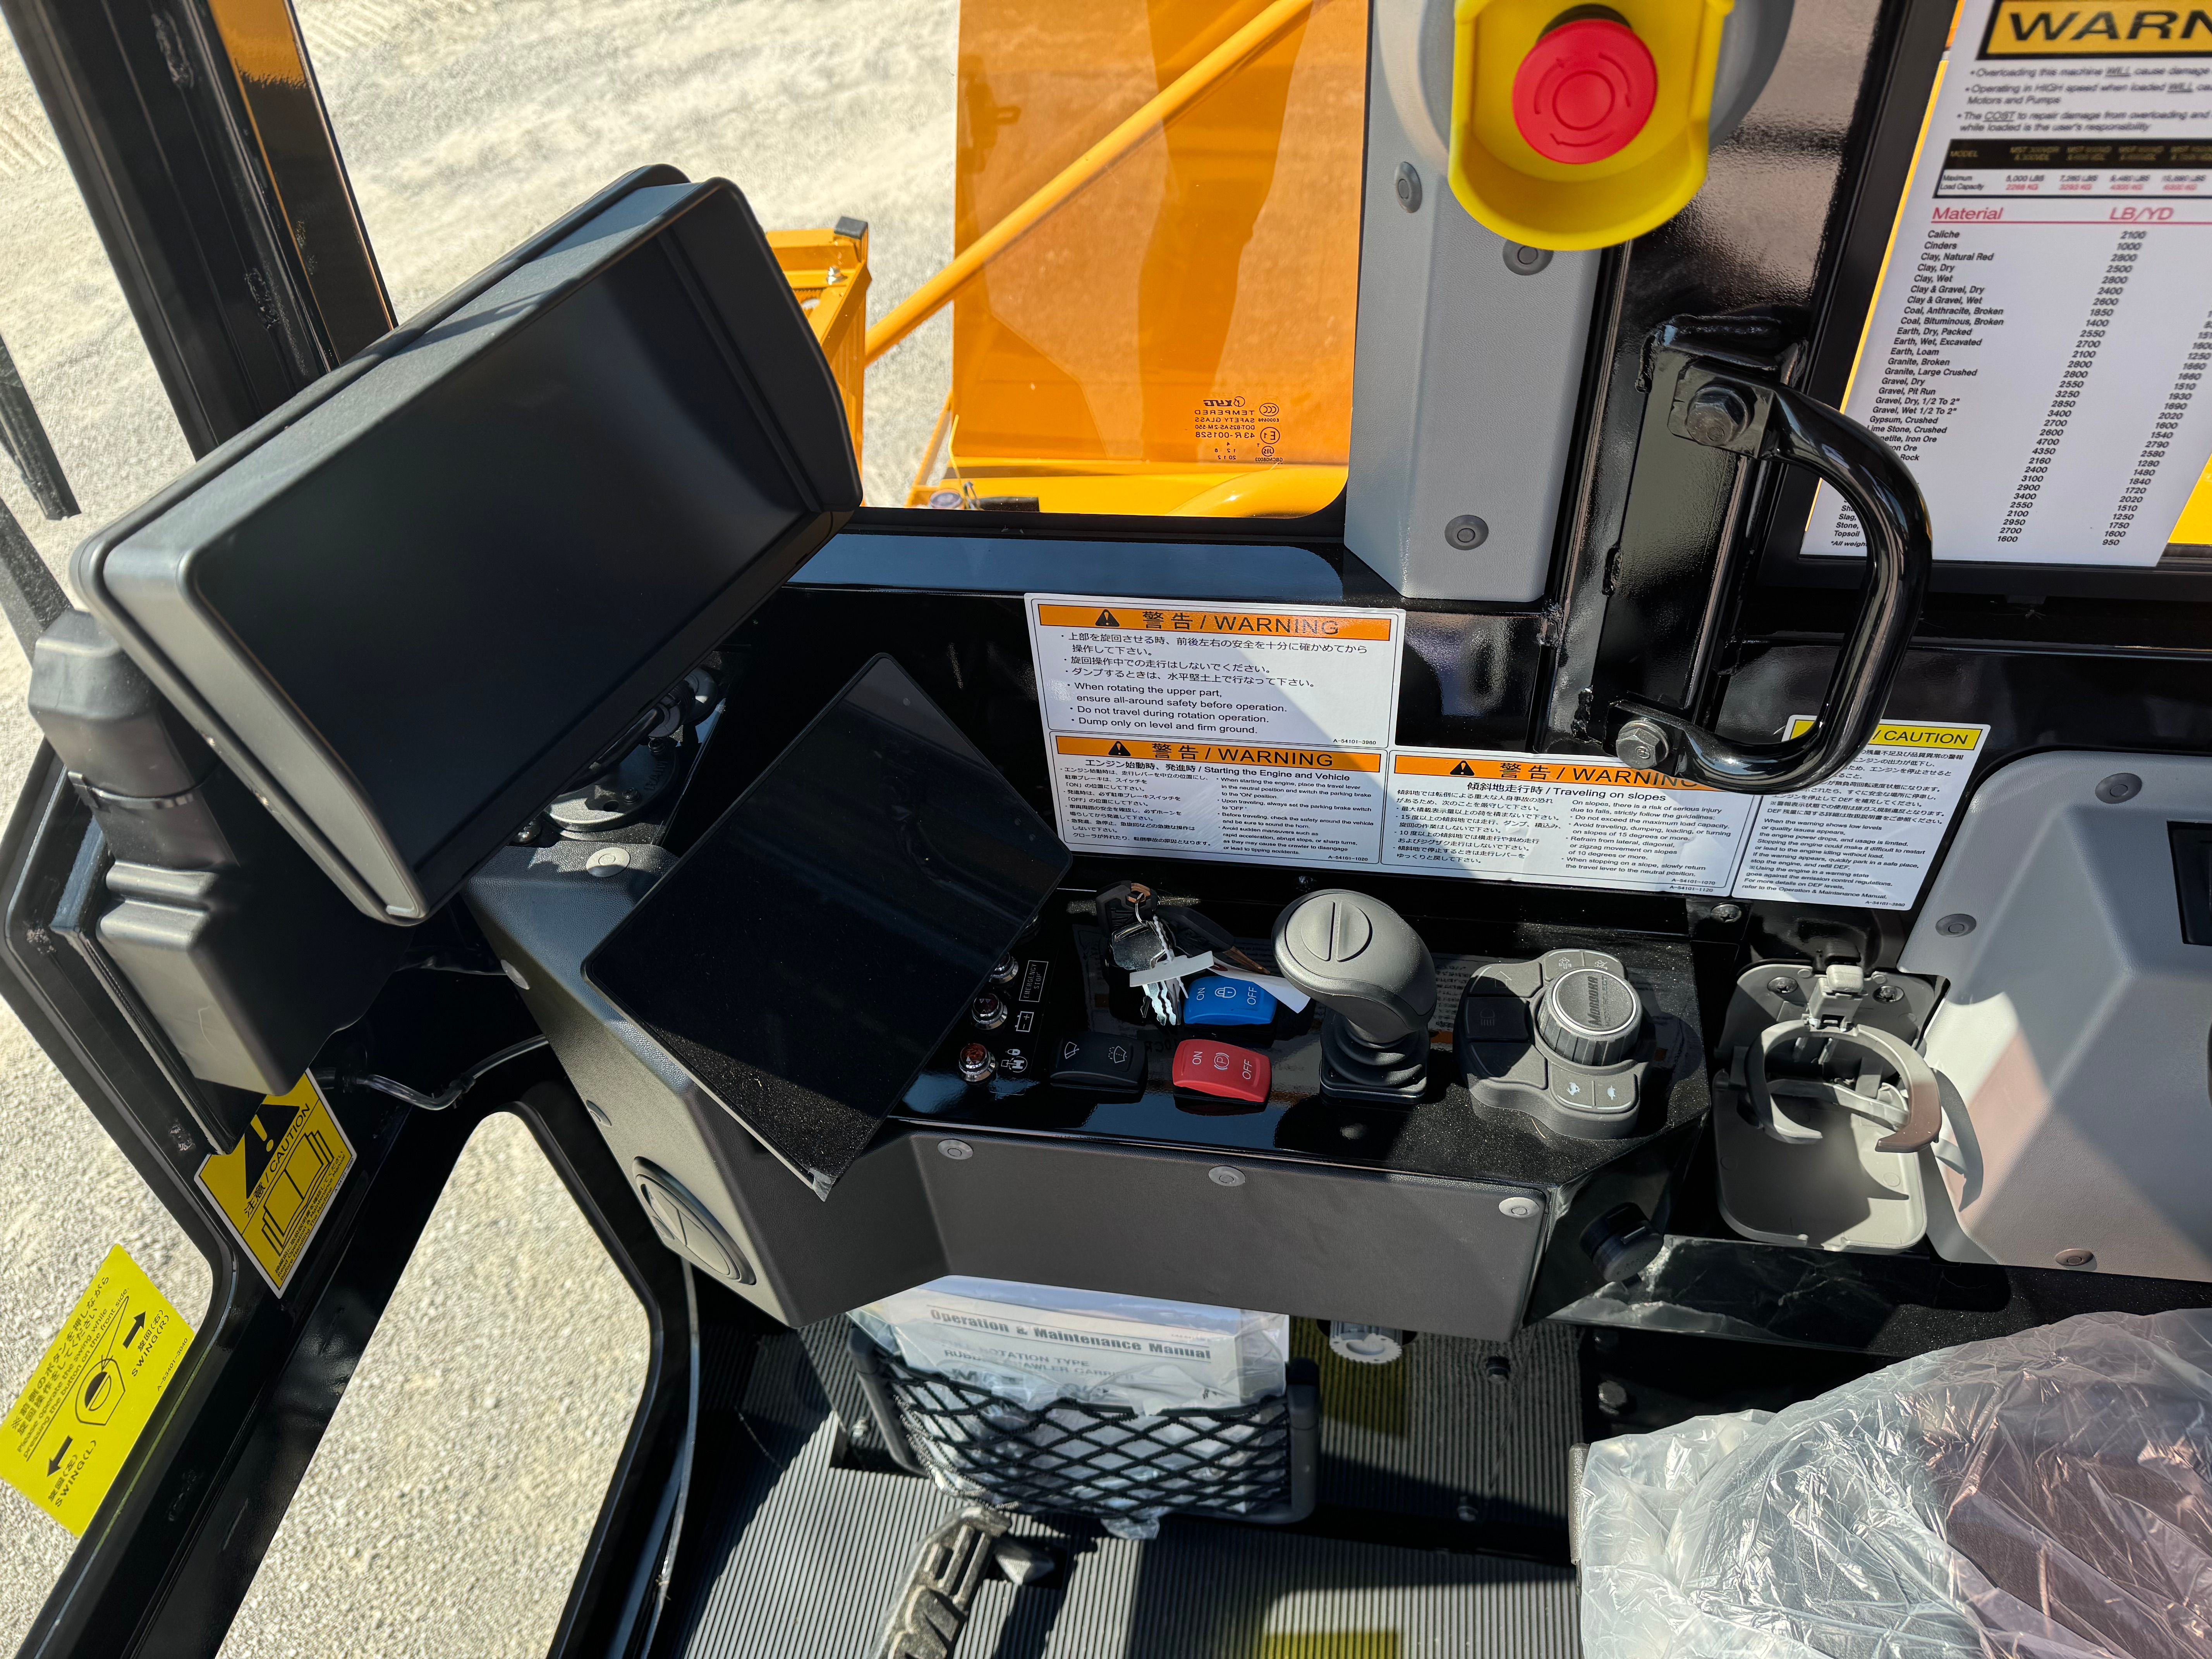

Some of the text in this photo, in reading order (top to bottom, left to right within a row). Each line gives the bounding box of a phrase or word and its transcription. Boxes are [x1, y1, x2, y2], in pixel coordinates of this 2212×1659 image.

[1975, 68, 2037, 79] Overloading
[2039, 68, 2057, 77] this
[2058, 68, 2104, 76] machine
[2105, 67, 2131, 78] WILL
[2167, 67, 2210, 77] damage
[1932, 207, 2003, 220] Material
[2110, 207, 2174, 221] LB/YD
[1927, 230, 1960, 238] Caliche
[1924, 241, 1957, 249] Cinders
[1921, 252, 1940, 262] Clay,
[1976, 252, 1994, 261] Red
[1904, 306, 2004, 316] Coal, Anthracite, Broken
[1893, 337, 1917, 346] Earth,
[1920, 338, 1937, 346] Wet,
[1884, 367, 1915, 376] Granite,
[1917, 368, 1941, 376] Large
[1887, 425, 1911, 433] Stone,
[1142, 611, 1193, 630] 警告
[1214, 615, 1339, 635] WARNING
[1068, 632, 1367, 654] 上部を旋回させる時、前後左右の安全を十分に確かめてから
[1072, 644, 1152, 656] 操作して下さい。
[1071, 656, 1270, 673] 旋回操作中での走行はしないでください。
[1072, 667, 1314, 687] ダンプするときは、水平堅土上で行なって下さい。
[1107, 685, 1144, 694] rotating
[1114, 696, 1163, 705] all-around
[1167, 699, 1197, 708] safety
[1200, 701, 1232, 709] before
[1143, 709, 1174, 719] during
[1079, 717, 1108, 726] Dump
[1111, 720, 1131, 728] only
[1150, 721, 1172, 729] level
[1884, 730, 1969, 745] CAUTION
[1152, 744, 1199, 760] 警告
[1218, 748, 1333, 766] WARNING
[1085, 759, 1196, 772] エンジン始動時、発進時
[1204, 766, 1239, 776] Starting
[1260, 769, 1291, 778] Engine
[1499, 762, 1551, 780] 警告
[1467, 782, 1543, 794] 傾斜地走行時
[1553, 788, 1606, 799] Traveling
[1628, 792, 1666, 801] slopes
[1023, 964, 1036, 998] EMERGENCY
[1197, 988, 1206, 1000] ON
[1247, 986, 1257, 1005] OFF
[1192, 1051, 1203, 1065] ON
[1242, 1059, 1253, 1079] OFF
[244, 1181, 266, 1218] 注意
[269, 1103, 310, 1173] CAUTION
[930, 1308, 1211, 1359] Operation & Maintenance Manual
[131, 1314, 171, 1377] SWING(R)
[157, 1338, 188, 1391] A-53401-3040
[1054, 1357, 1089, 1366] TYPE
[17, 1309, 107, 1452] Please operate the swing while
[23, 1288, 129, 1458] pressing the button on the front side.
[54, 1438, 98, 1508] SWING(L)
